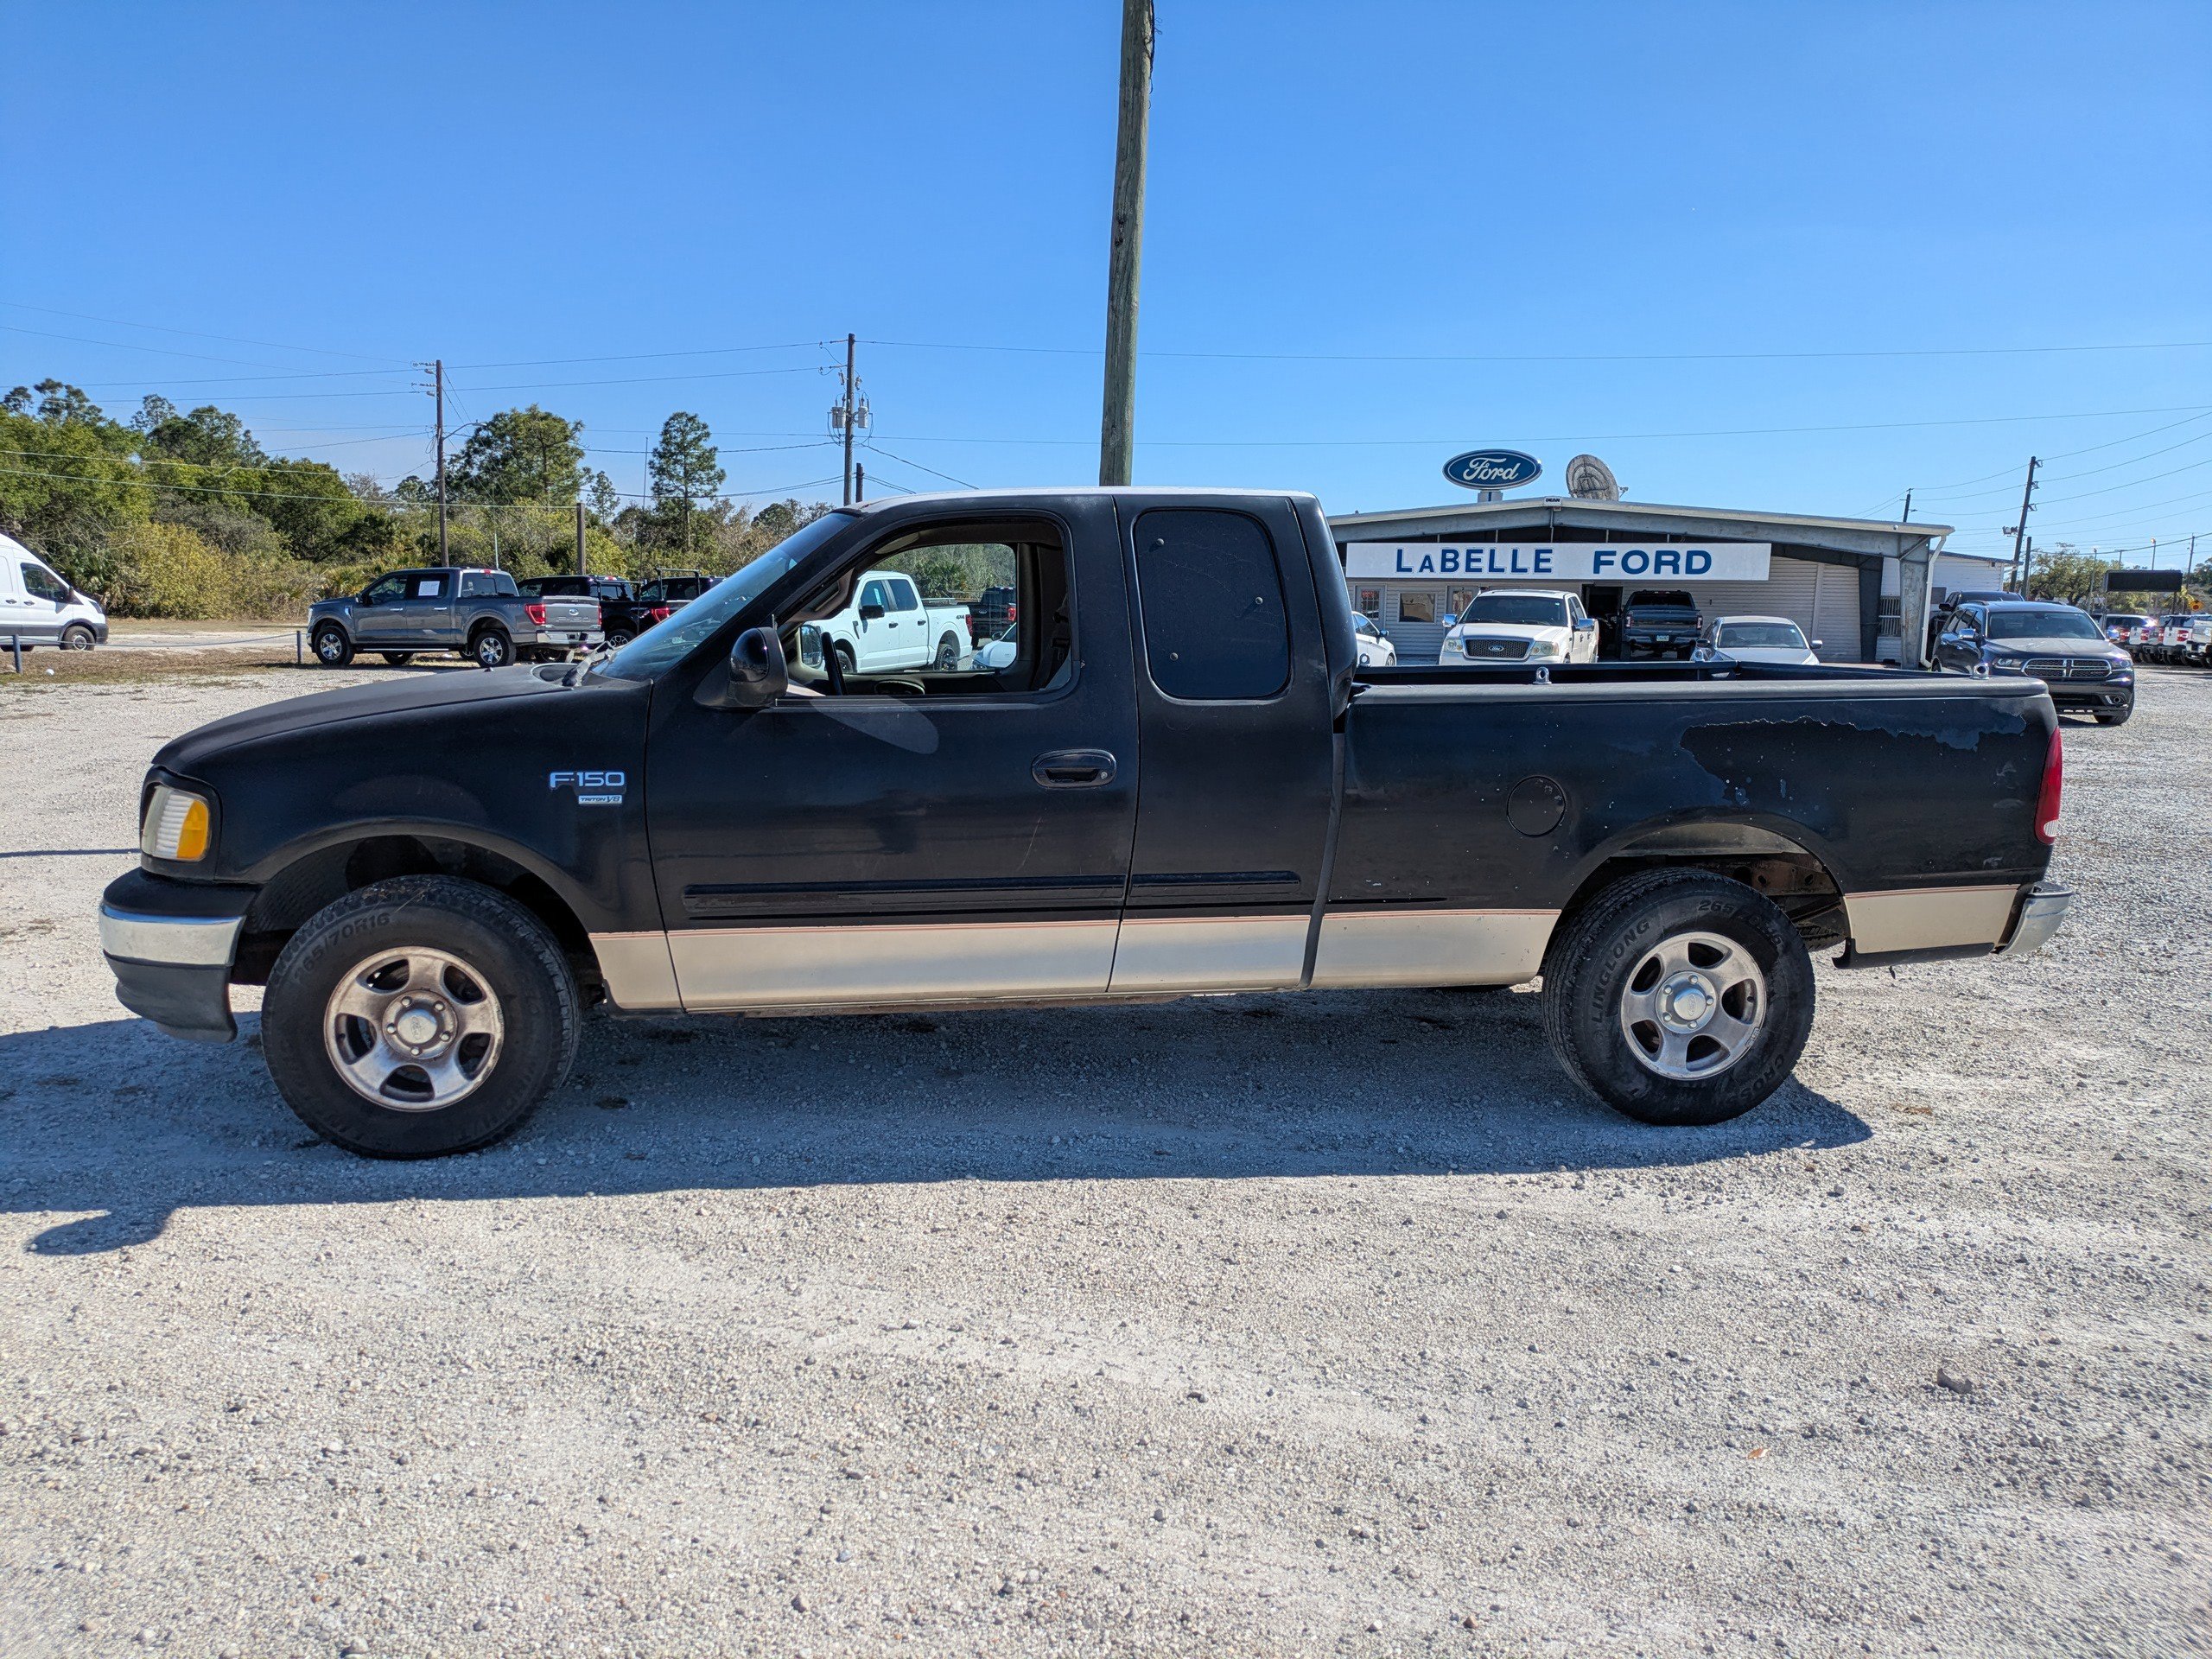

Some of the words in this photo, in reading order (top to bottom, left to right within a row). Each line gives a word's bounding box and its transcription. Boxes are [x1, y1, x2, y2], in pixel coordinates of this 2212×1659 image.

[1462, 457, 1522, 480] Ford
[1592, 550, 1713, 575] FORD
[550, 772, 625, 788] F-150
[1592, 919, 1650, 1024] LINGLONG
